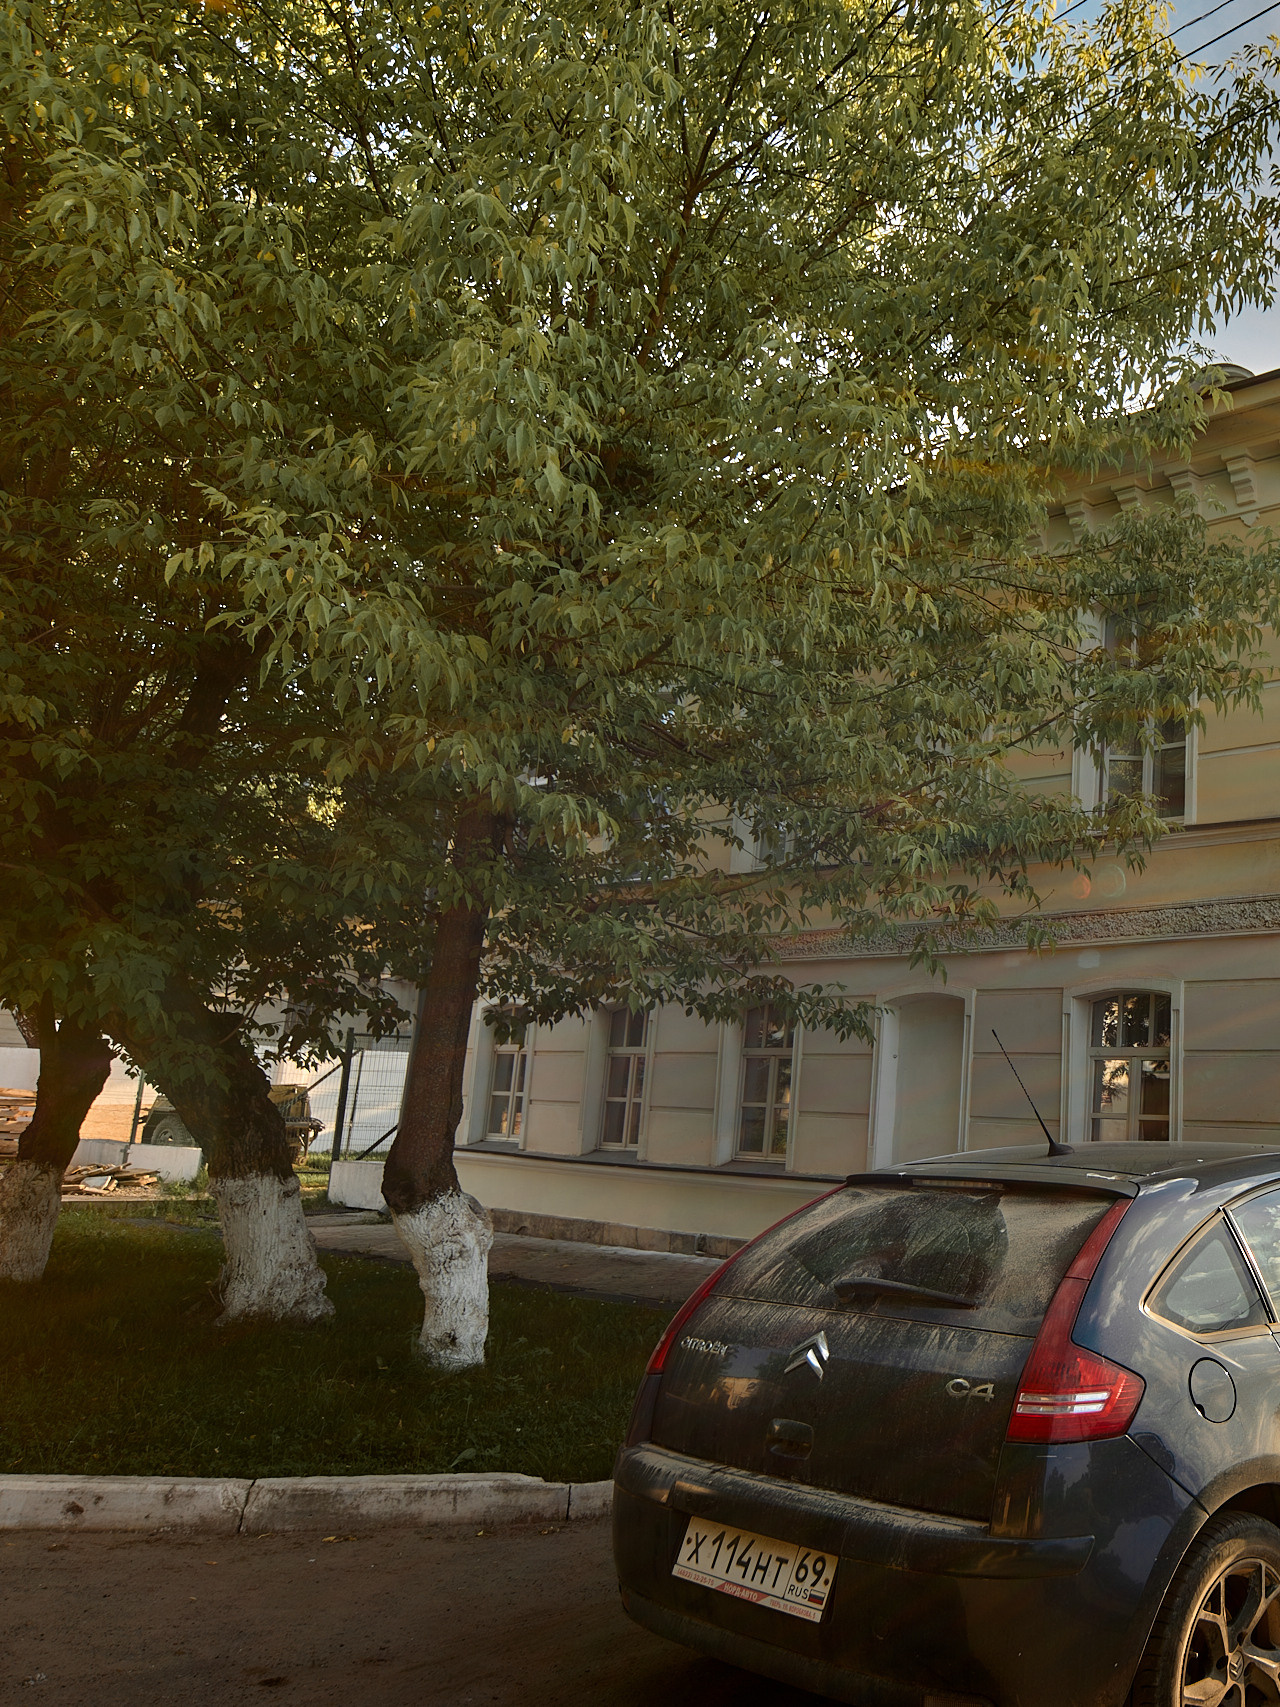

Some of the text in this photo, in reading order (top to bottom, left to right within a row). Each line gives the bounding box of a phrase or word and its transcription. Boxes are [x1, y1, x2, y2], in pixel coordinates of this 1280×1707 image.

[945, 1378, 995, 1402] C4
[795, 1552, 827, 1588] 69
[787, 1584, 809, 1600] RUS
